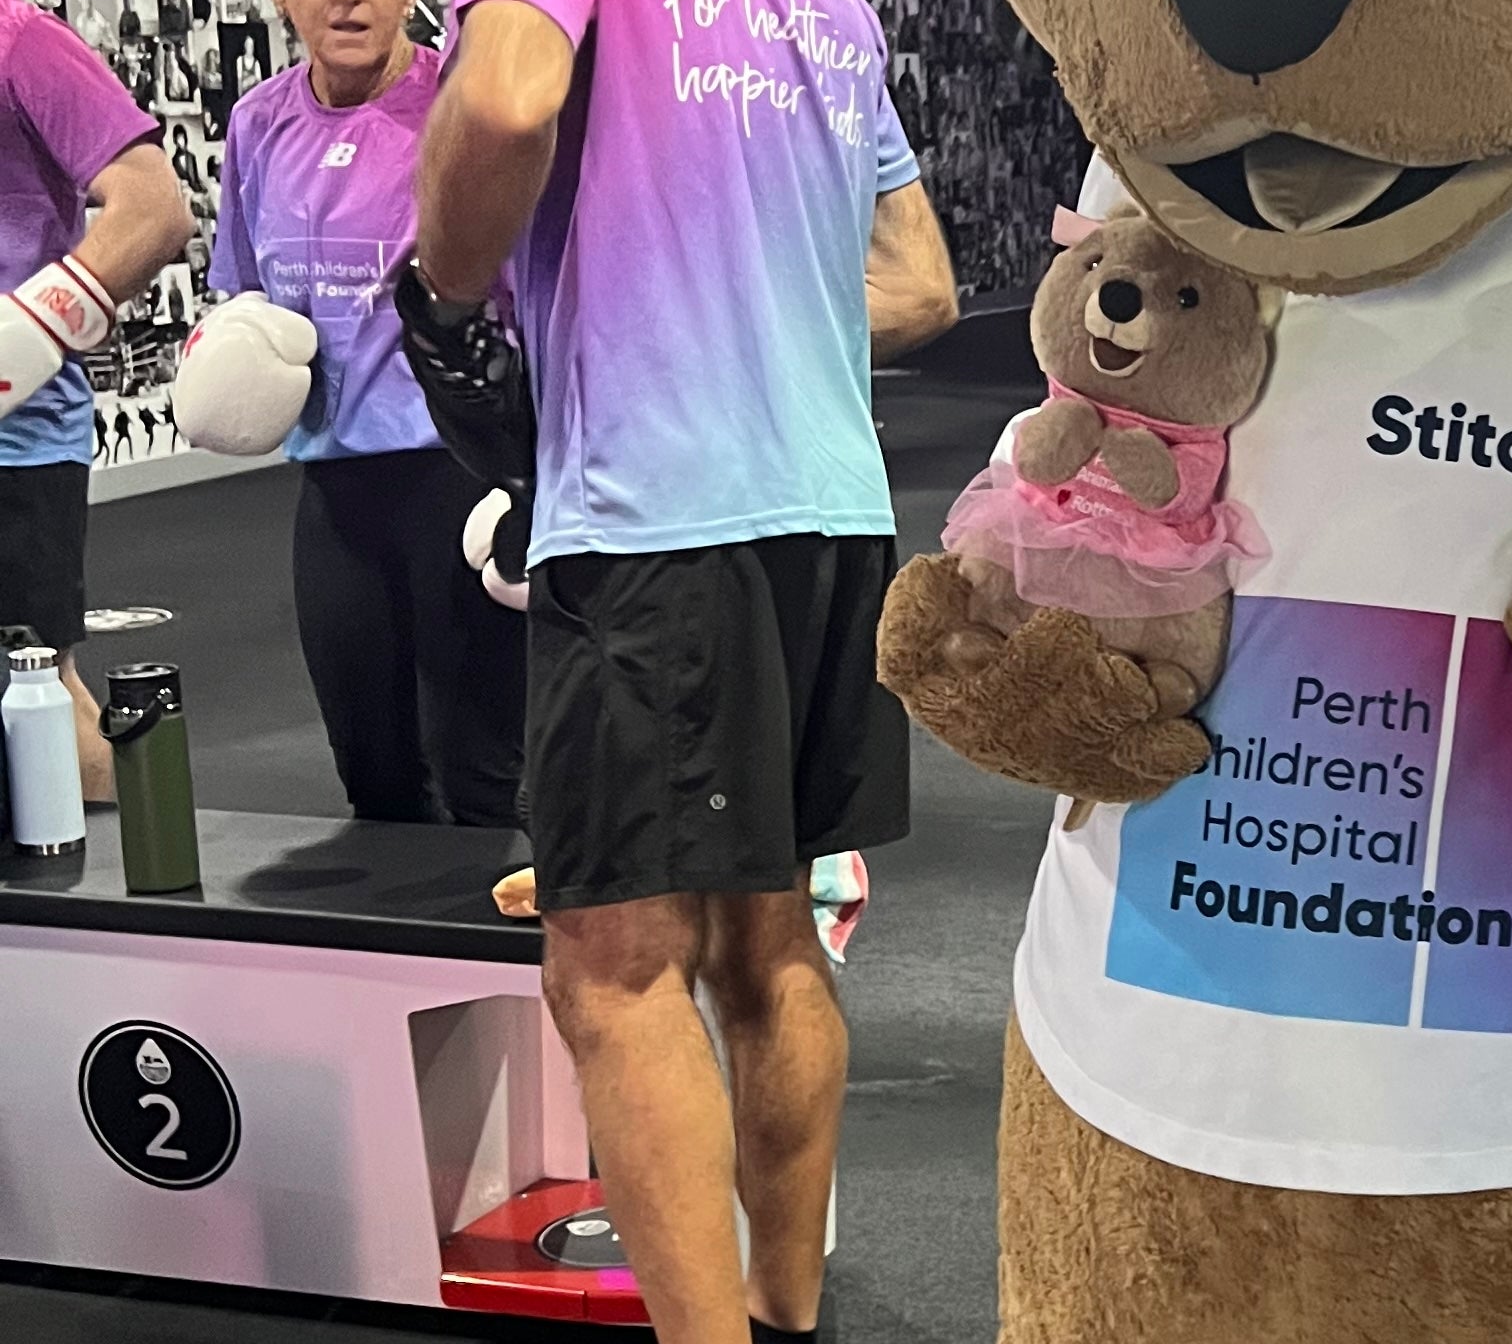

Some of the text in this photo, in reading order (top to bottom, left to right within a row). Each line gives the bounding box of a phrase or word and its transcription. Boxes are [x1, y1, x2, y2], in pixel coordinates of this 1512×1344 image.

[673, 41, 807, 138] happier
[312, 261, 379, 281] hildren's
[1292, 676, 1431, 733] Perth
[1193, 734, 1425, 799] hildren's
[1203, 799, 1418, 865] Hospital
[1170, 860, 1512, 947] Foundation
[138, 1094, 188, 1161] 2
